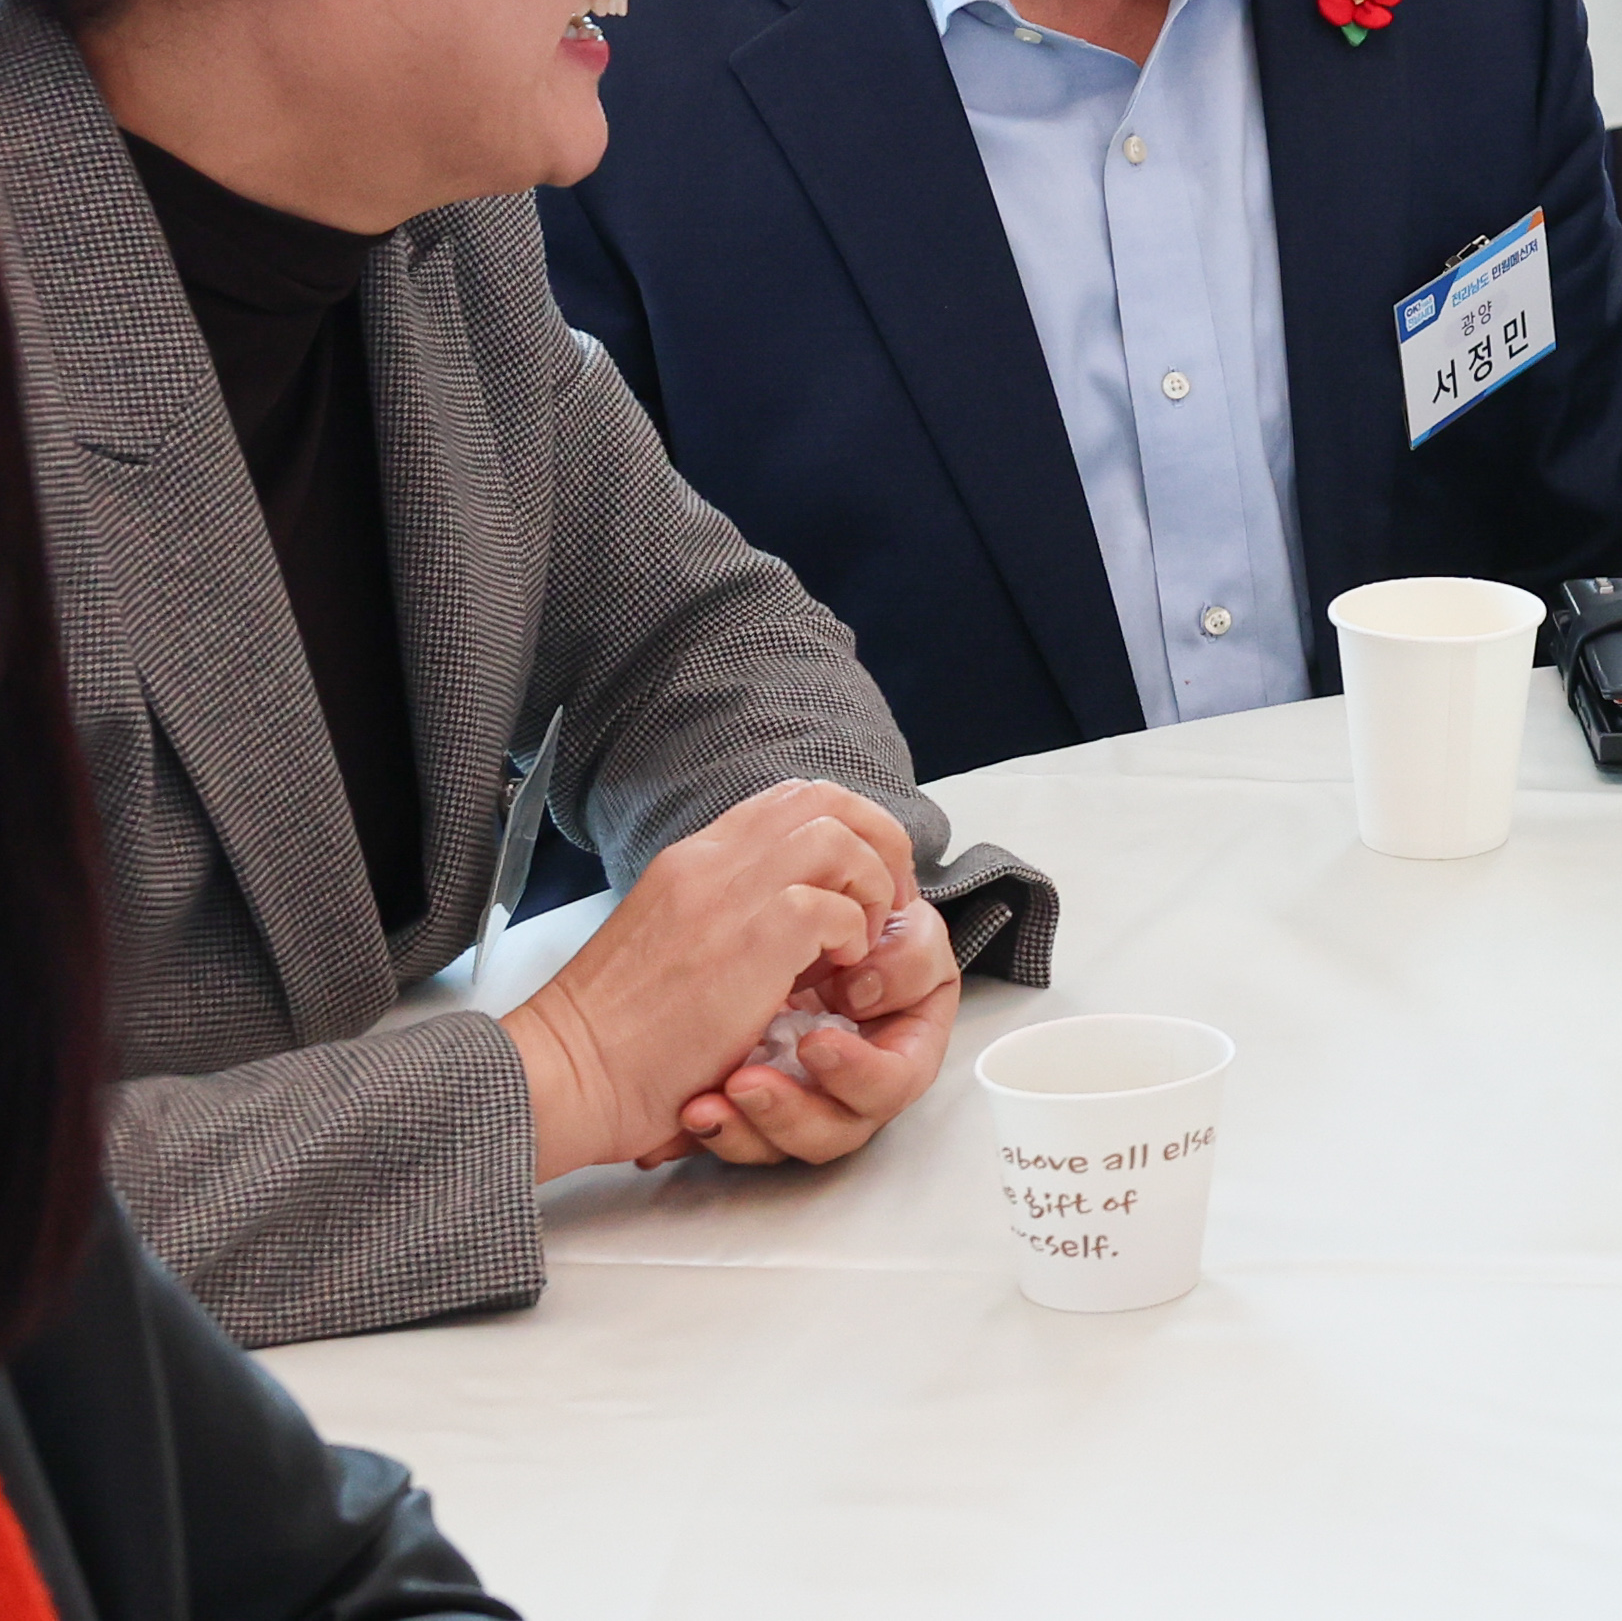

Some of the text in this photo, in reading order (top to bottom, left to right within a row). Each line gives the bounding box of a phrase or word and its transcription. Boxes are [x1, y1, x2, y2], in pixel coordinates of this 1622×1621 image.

[1461, 300, 1492, 336] 광양
[1432, 310, 1529, 404] 서정민
[1002, 1146, 1089, 1173] above
[1102, 1144, 1148, 1170] all
[1024, 1187, 1092, 1219] gift
[1103, 1189, 1137, 1214] of
